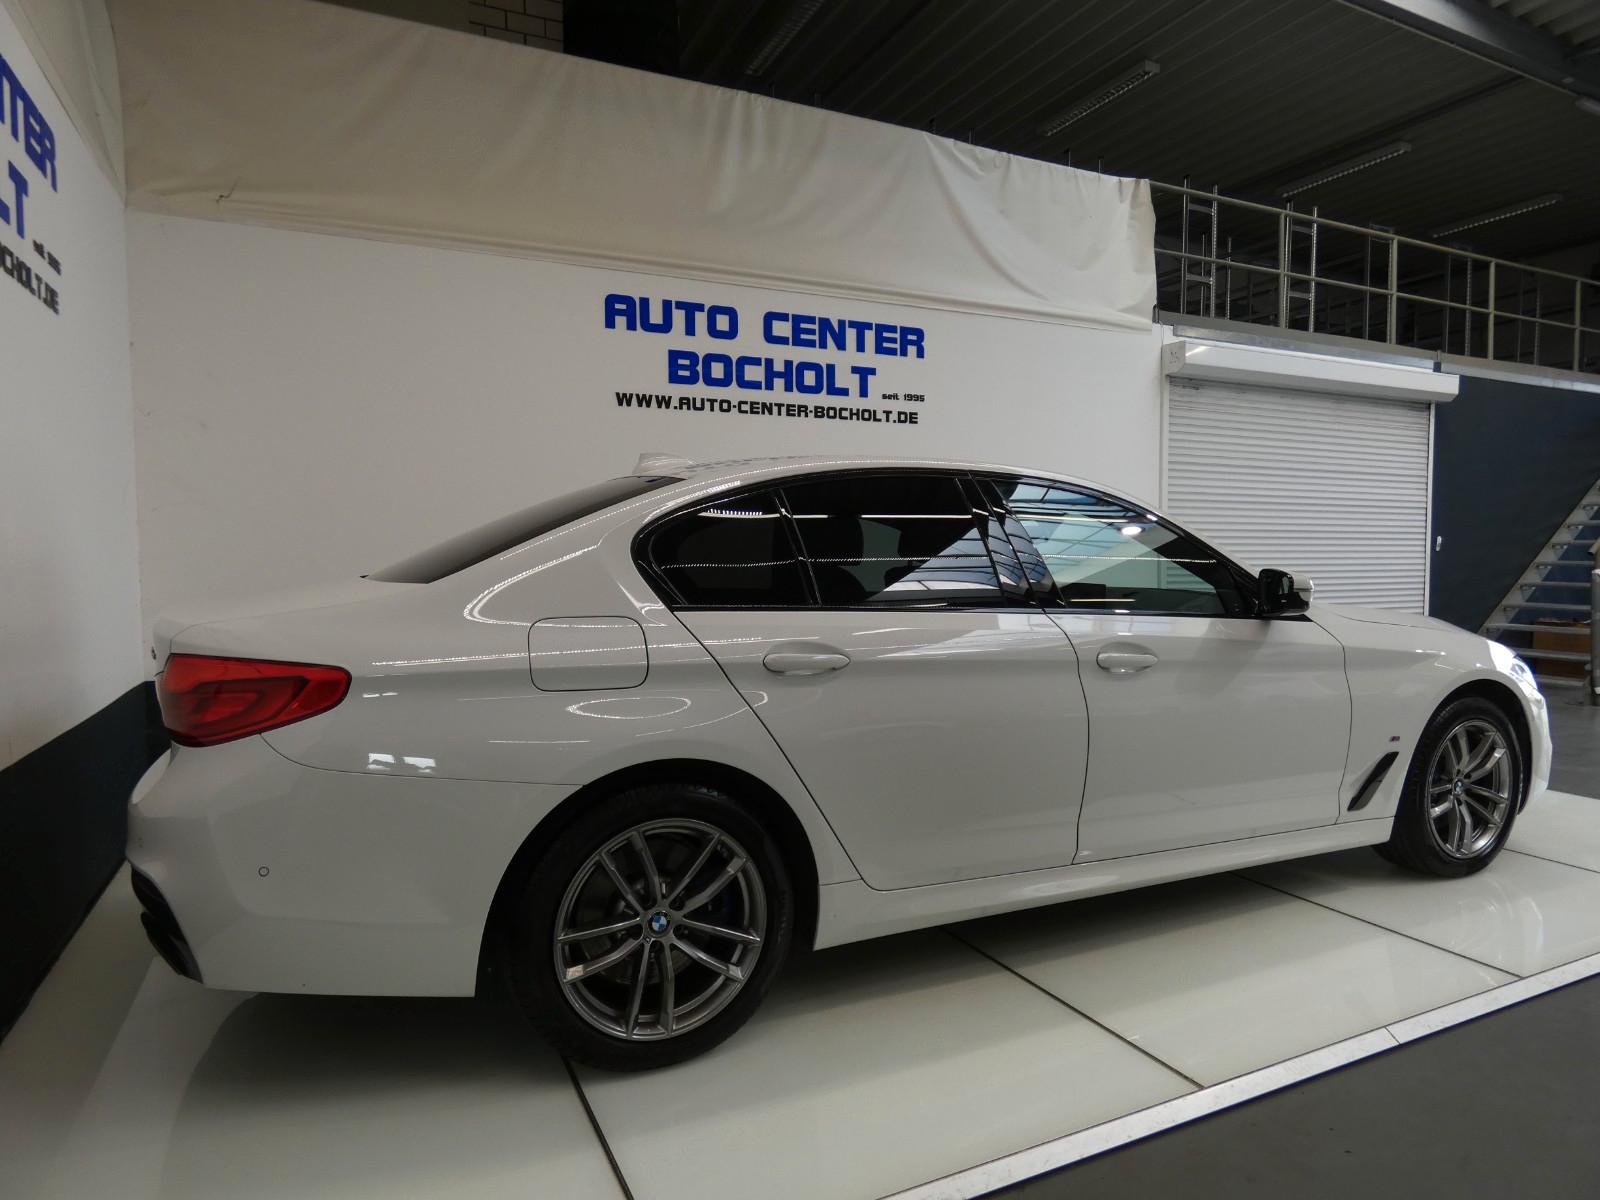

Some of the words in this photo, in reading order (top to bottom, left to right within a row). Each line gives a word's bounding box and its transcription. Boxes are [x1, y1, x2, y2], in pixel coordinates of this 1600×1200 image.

[604, 293, 739, 341] AUTO
[763, 311, 925, 359] CENTER
[668, 349, 877, 398] BOCHOLT
[615, 391, 919, 425] WWW.AUTO-CENTER-BOCHOLT.DE
[882, 393, 900, 401] seit
[903, 393, 925, 403] 1995
